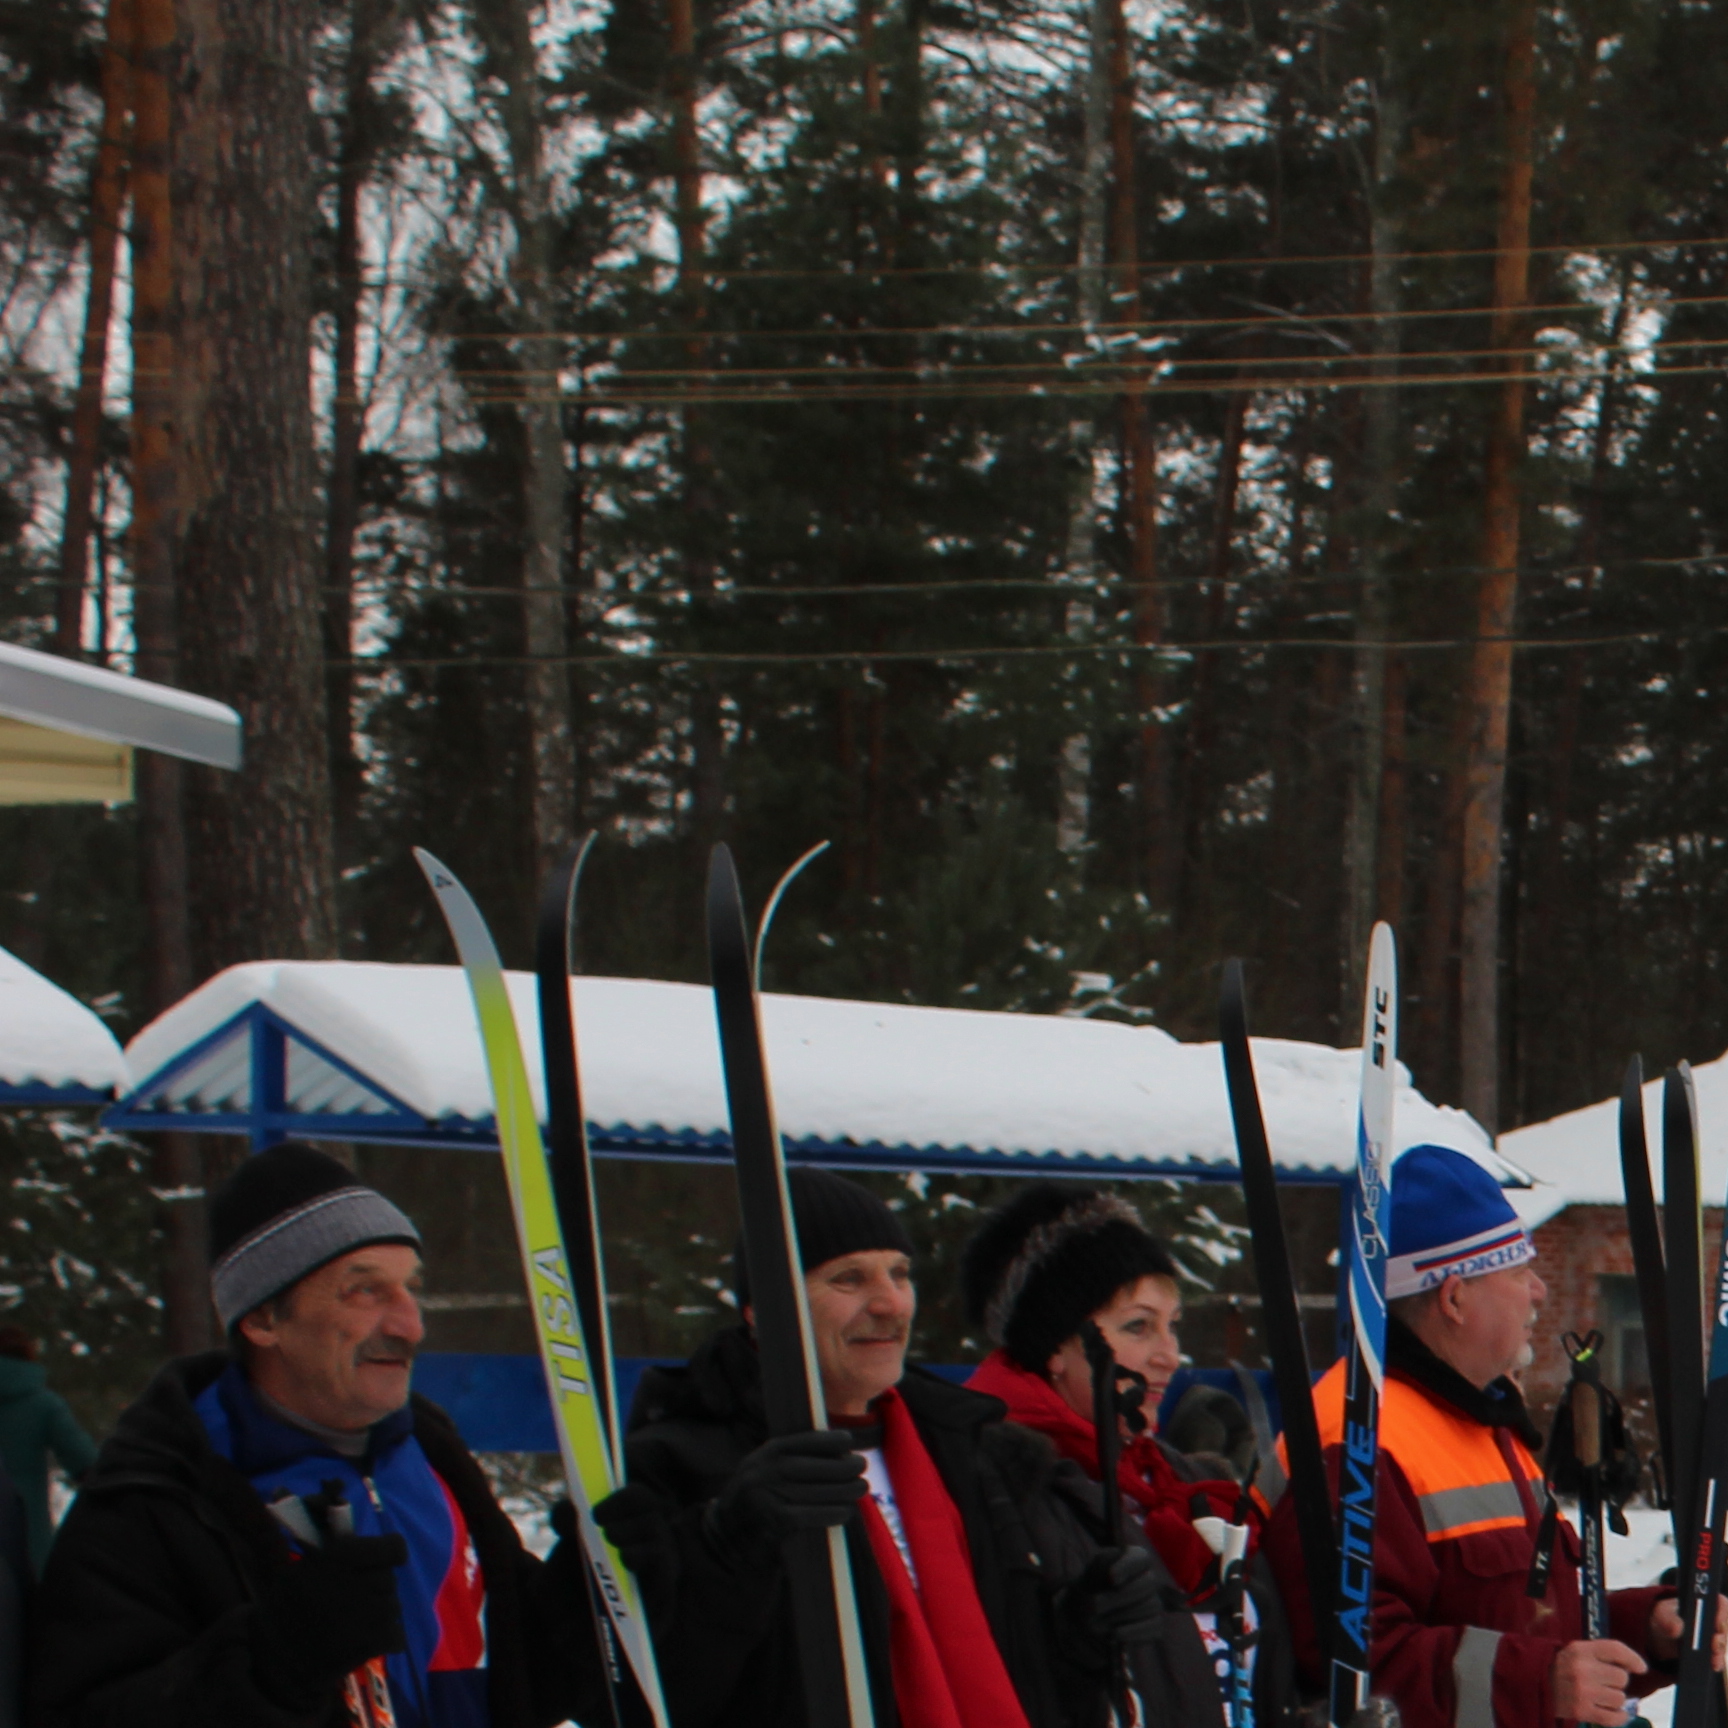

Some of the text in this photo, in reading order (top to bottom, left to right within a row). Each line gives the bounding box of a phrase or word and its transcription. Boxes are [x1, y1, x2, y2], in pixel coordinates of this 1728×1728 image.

[1372, 985, 1389, 1071] STC
[1361, 1141, 1382, 1260] CLASSIC
[533, 1246, 590, 1402] TISA
[1338, 1420, 1376, 1654] ACTIVE
[1696, 1531, 1713, 1570] PRO
